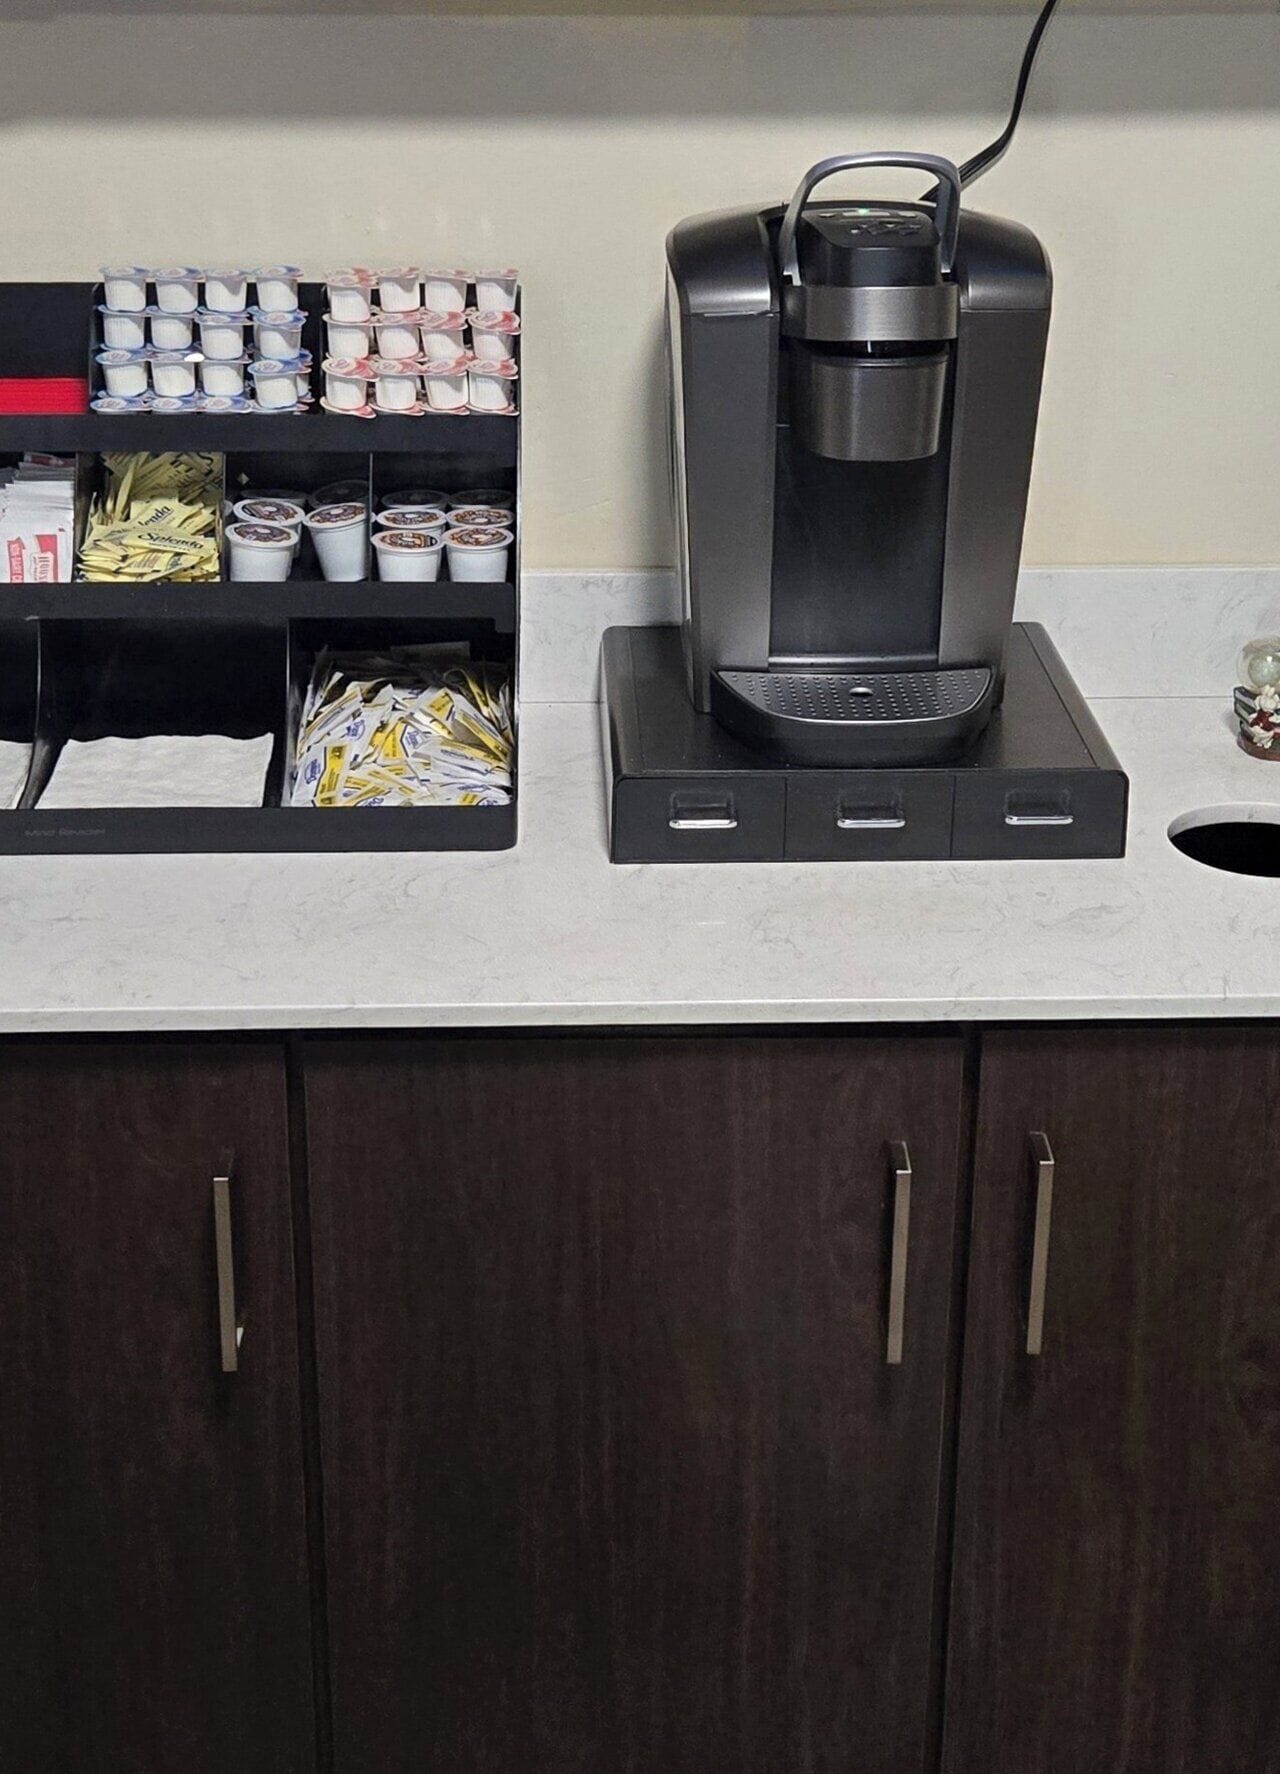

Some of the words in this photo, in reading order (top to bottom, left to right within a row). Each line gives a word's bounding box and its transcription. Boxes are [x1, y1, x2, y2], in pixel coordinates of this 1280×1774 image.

[137, 505, 172, 528] lenda
[137, 532, 205, 550] Splenda
[38, 556, 50, 583] HOUS
